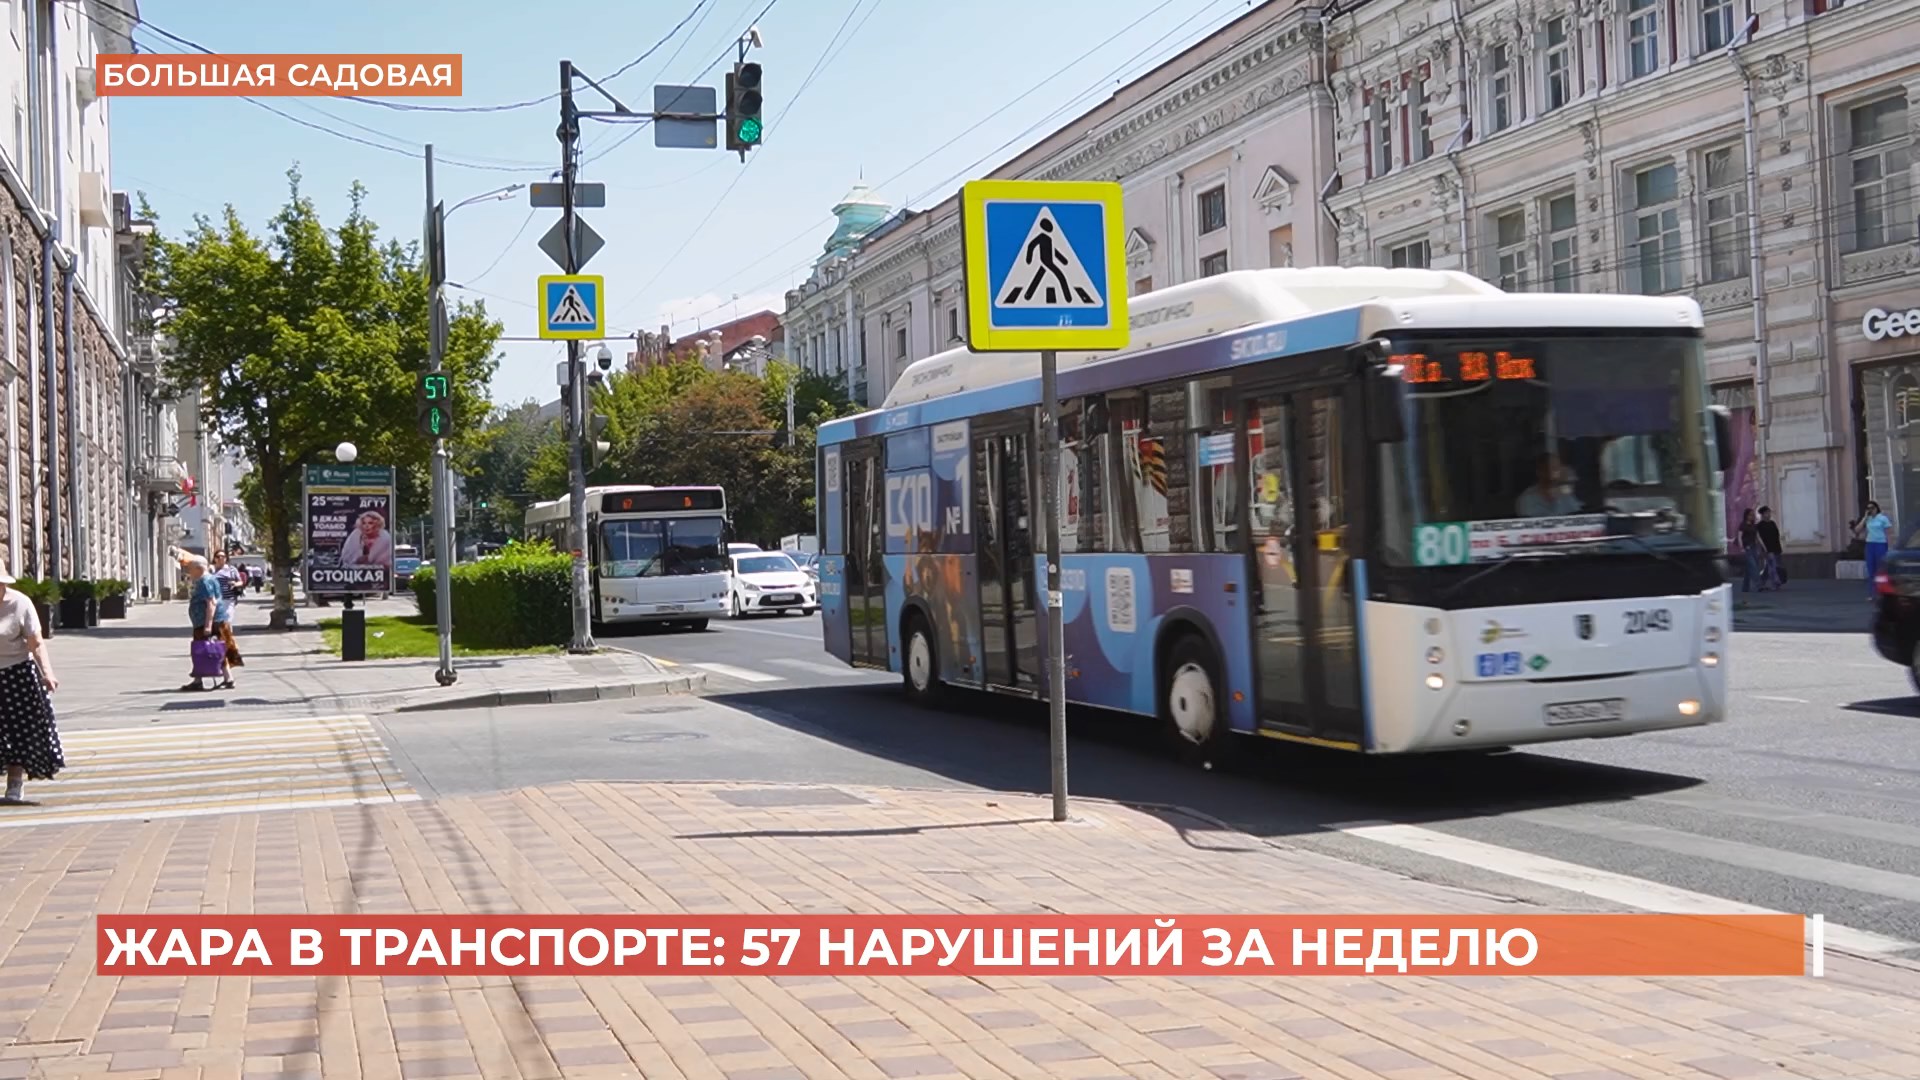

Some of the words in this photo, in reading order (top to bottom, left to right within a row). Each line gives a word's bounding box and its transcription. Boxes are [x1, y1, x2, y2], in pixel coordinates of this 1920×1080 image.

[425, 376, 447, 399] 57
[311, 495, 326, 506] 25
[359, 500, 387, 508] ДГТУ
[319, 515, 348, 523] ДЖАЗЕ
[1416, 525, 1465, 565] 80
[311, 569, 384, 584] СТОЦКАЯ
[1623, 608, 1673, 634] 2049
